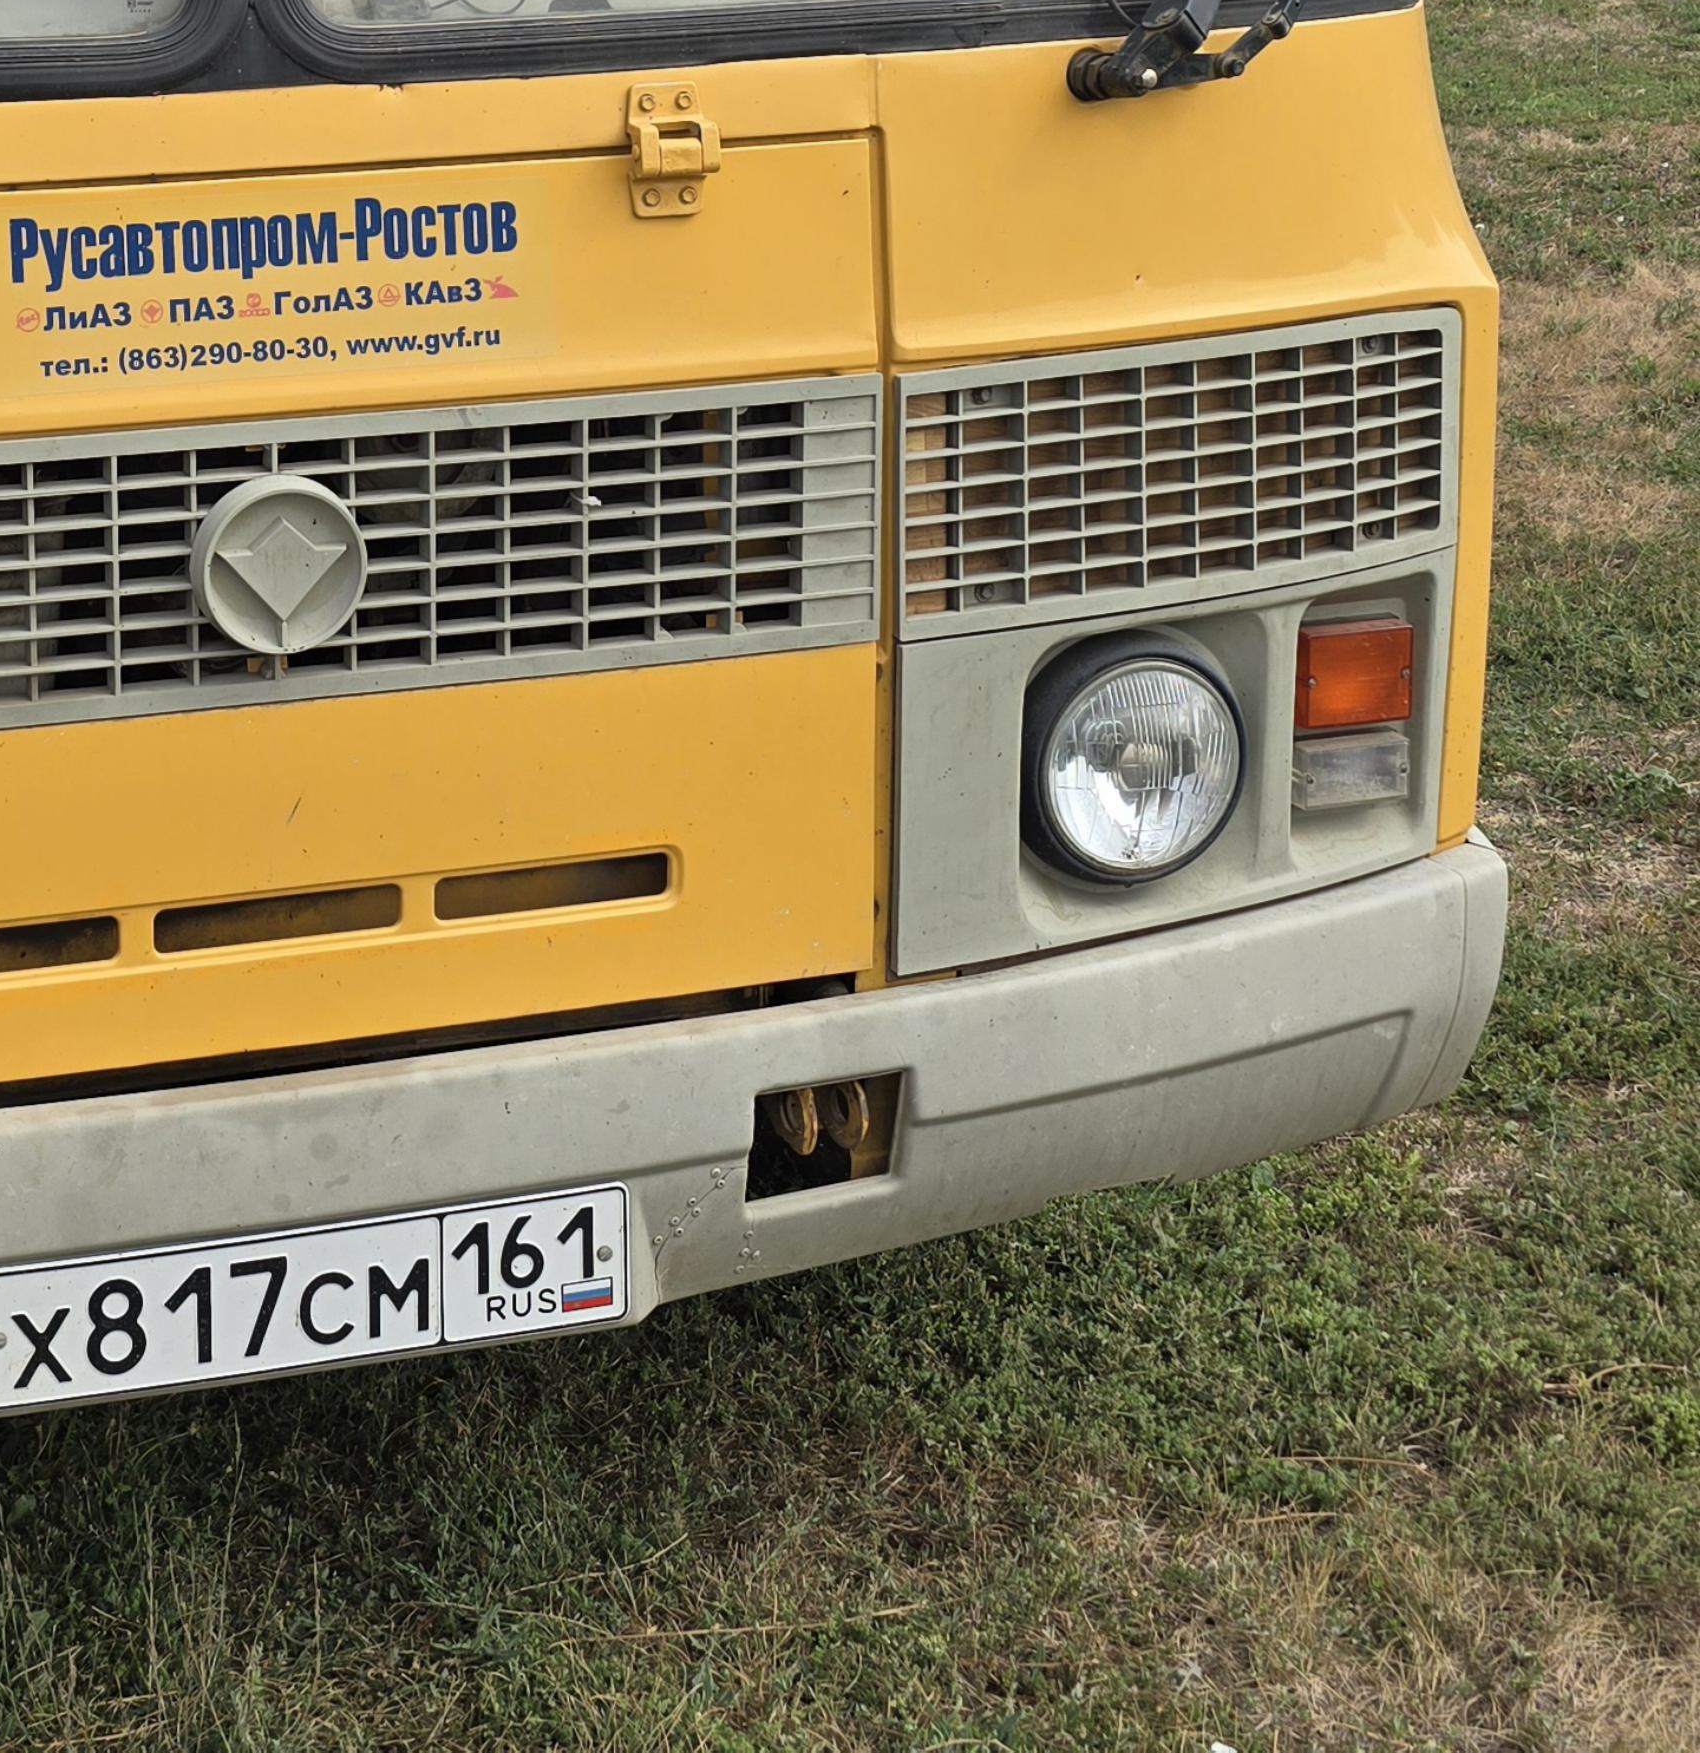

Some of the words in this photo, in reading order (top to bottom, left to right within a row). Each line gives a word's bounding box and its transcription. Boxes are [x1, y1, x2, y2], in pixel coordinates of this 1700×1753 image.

[9, 197, 518, 292] Русавтопром-Ростов
[44, 302, 132, 331] ЛиАЗ
[169, 294, 235, 324] ПАЗ
[274, 285, 374, 316] ГолАЗ
[405, 277, 483, 306] КАвЗ
[40, 355, 109, 377] тел.:
[117, 335, 338, 375] (863)290-80-30,
[347, 325, 501, 357] www.gvf.ru
[452, 1206, 596, 1295] 161
[486, 1286, 557, 1323] RUS
